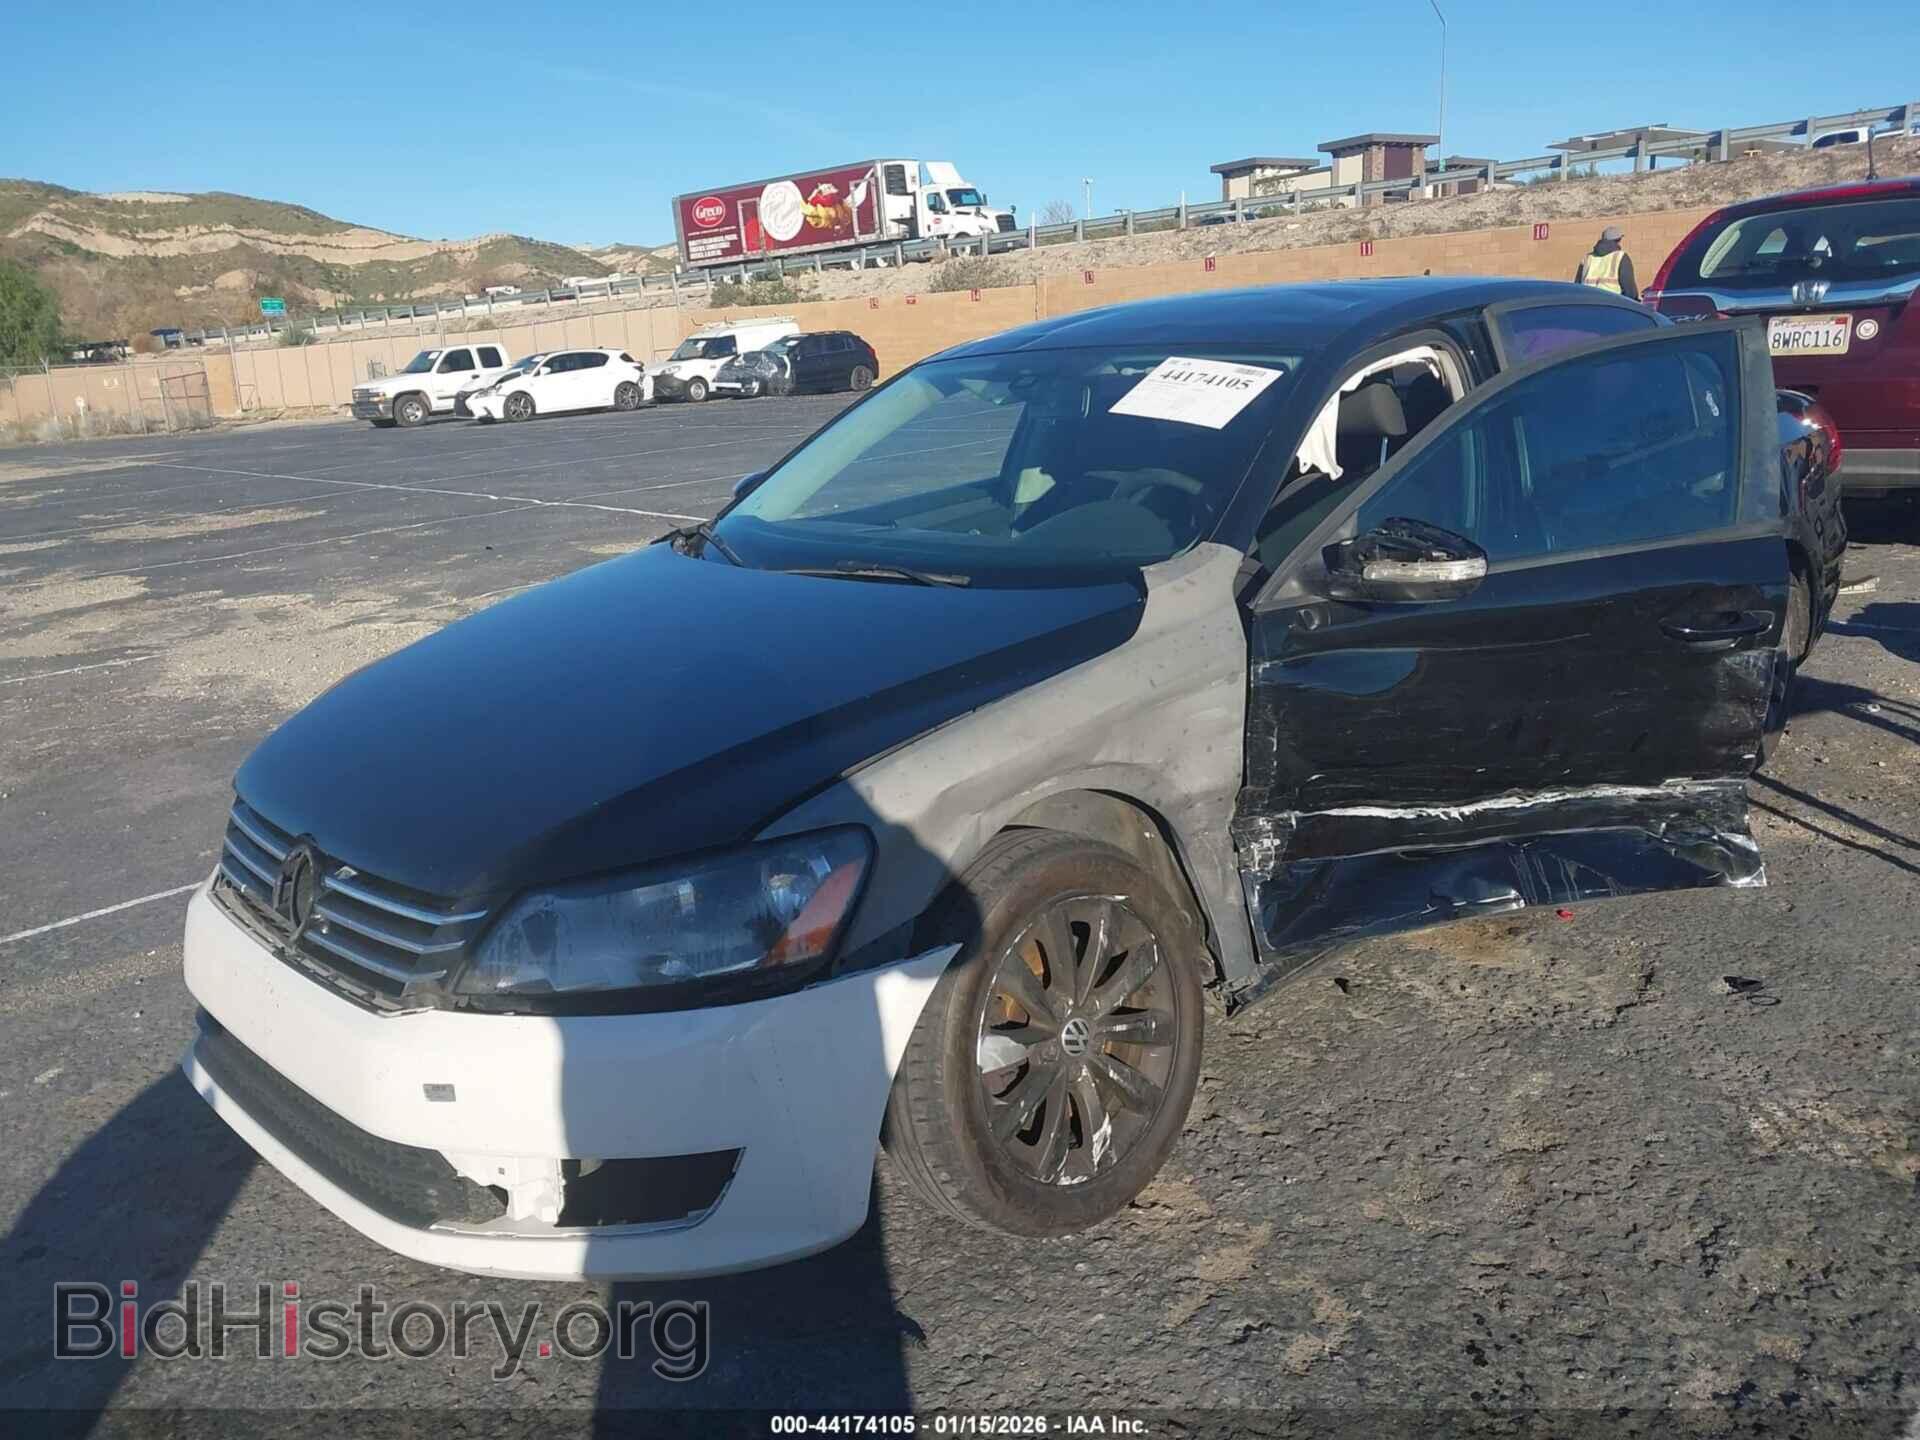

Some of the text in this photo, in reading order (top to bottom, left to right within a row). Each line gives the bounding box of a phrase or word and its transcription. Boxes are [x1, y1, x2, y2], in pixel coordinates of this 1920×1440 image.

[1536, 225, 1548, 239] 10
[1771, 329, 1842, 349] 8WRC116
[1160, 369, 1255, 389] 44174105
